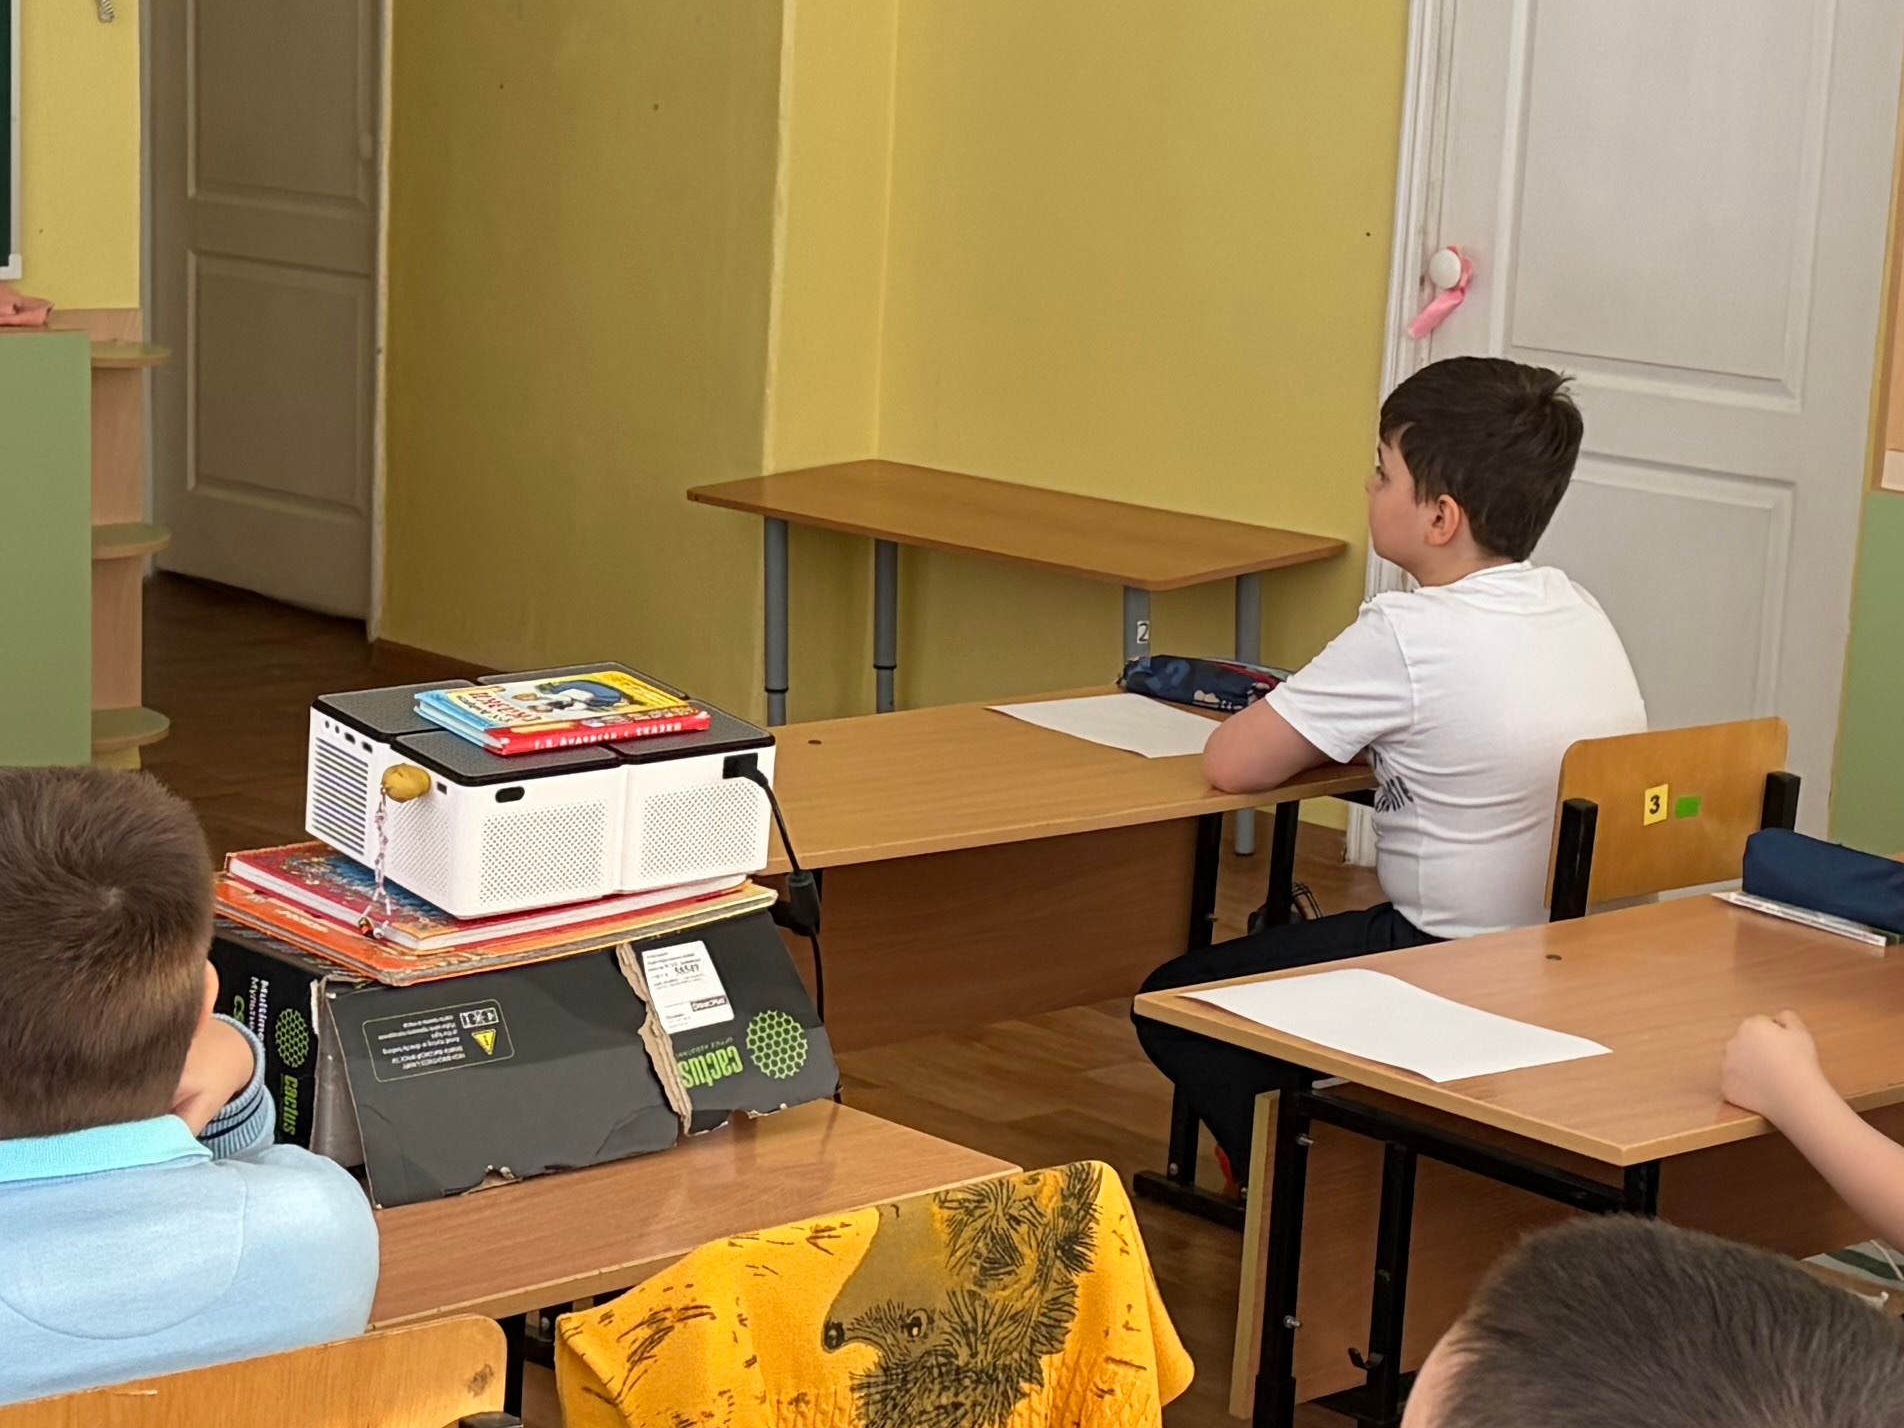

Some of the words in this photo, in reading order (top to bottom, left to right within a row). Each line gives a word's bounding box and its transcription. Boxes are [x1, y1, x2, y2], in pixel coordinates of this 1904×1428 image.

[1138, 623, 1149, 642] 2
[1649, 795, 1661, 815] 3
[676, 1045, 744, 1088] cactus
[284, 1074, 298, 1136] cactus
